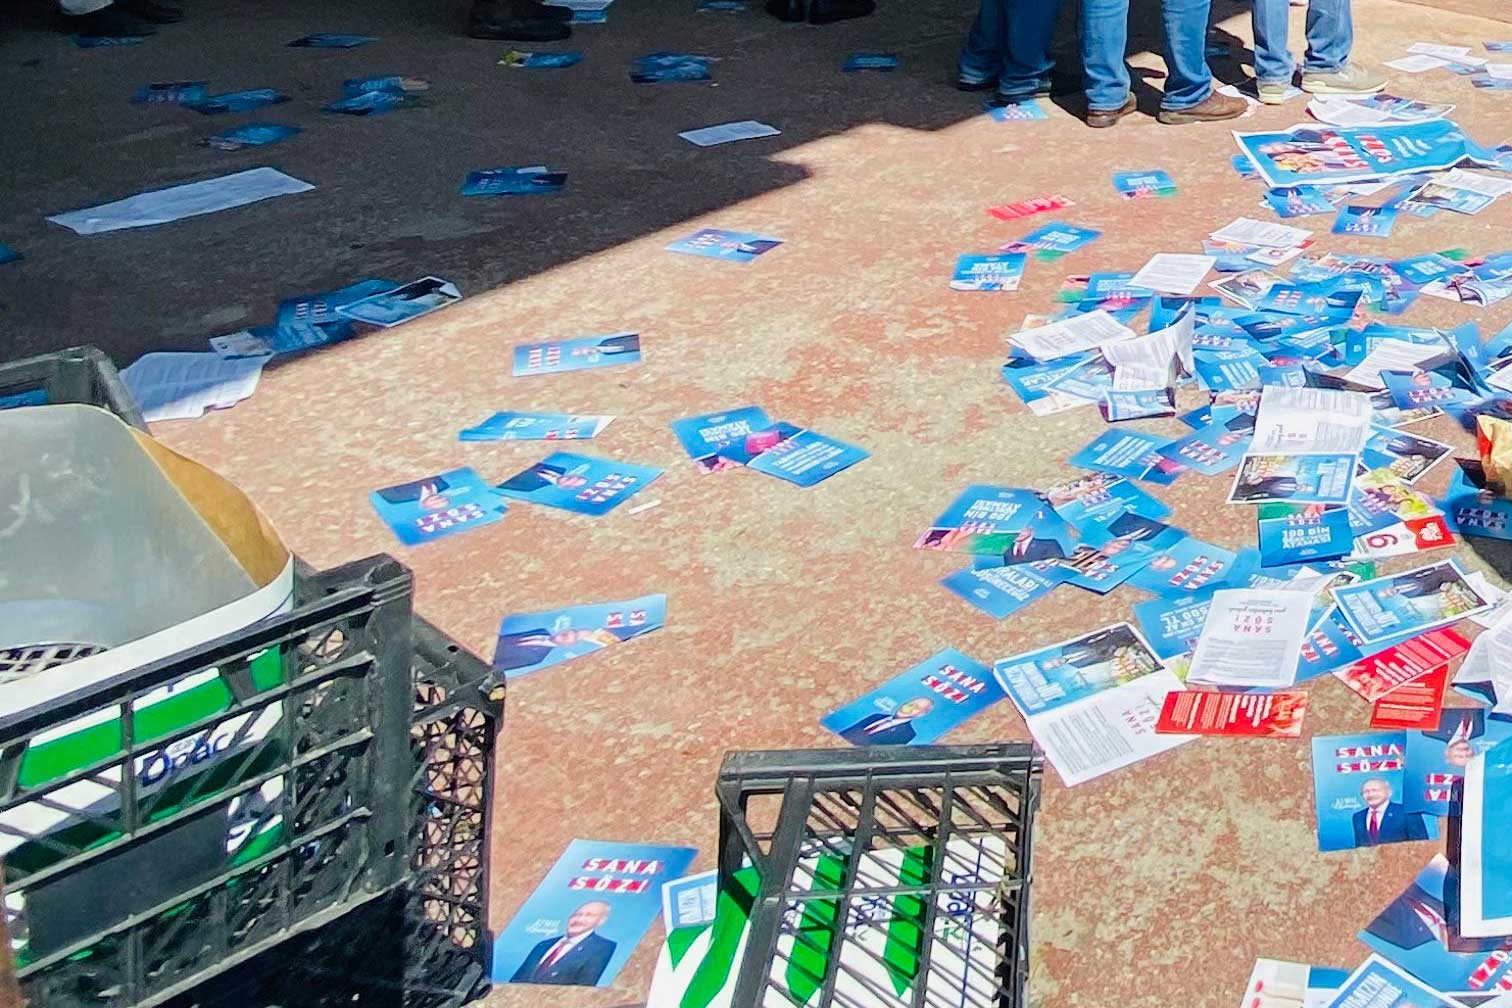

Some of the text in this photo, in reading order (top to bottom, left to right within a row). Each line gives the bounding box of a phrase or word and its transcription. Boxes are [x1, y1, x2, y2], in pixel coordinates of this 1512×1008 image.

[938, 665, 986, 694] SANA
[1338, 744, 1401, 760] SANA
[584, 857, 661, 875] SANA
[569, 874, 649, 894] SÖZ!
